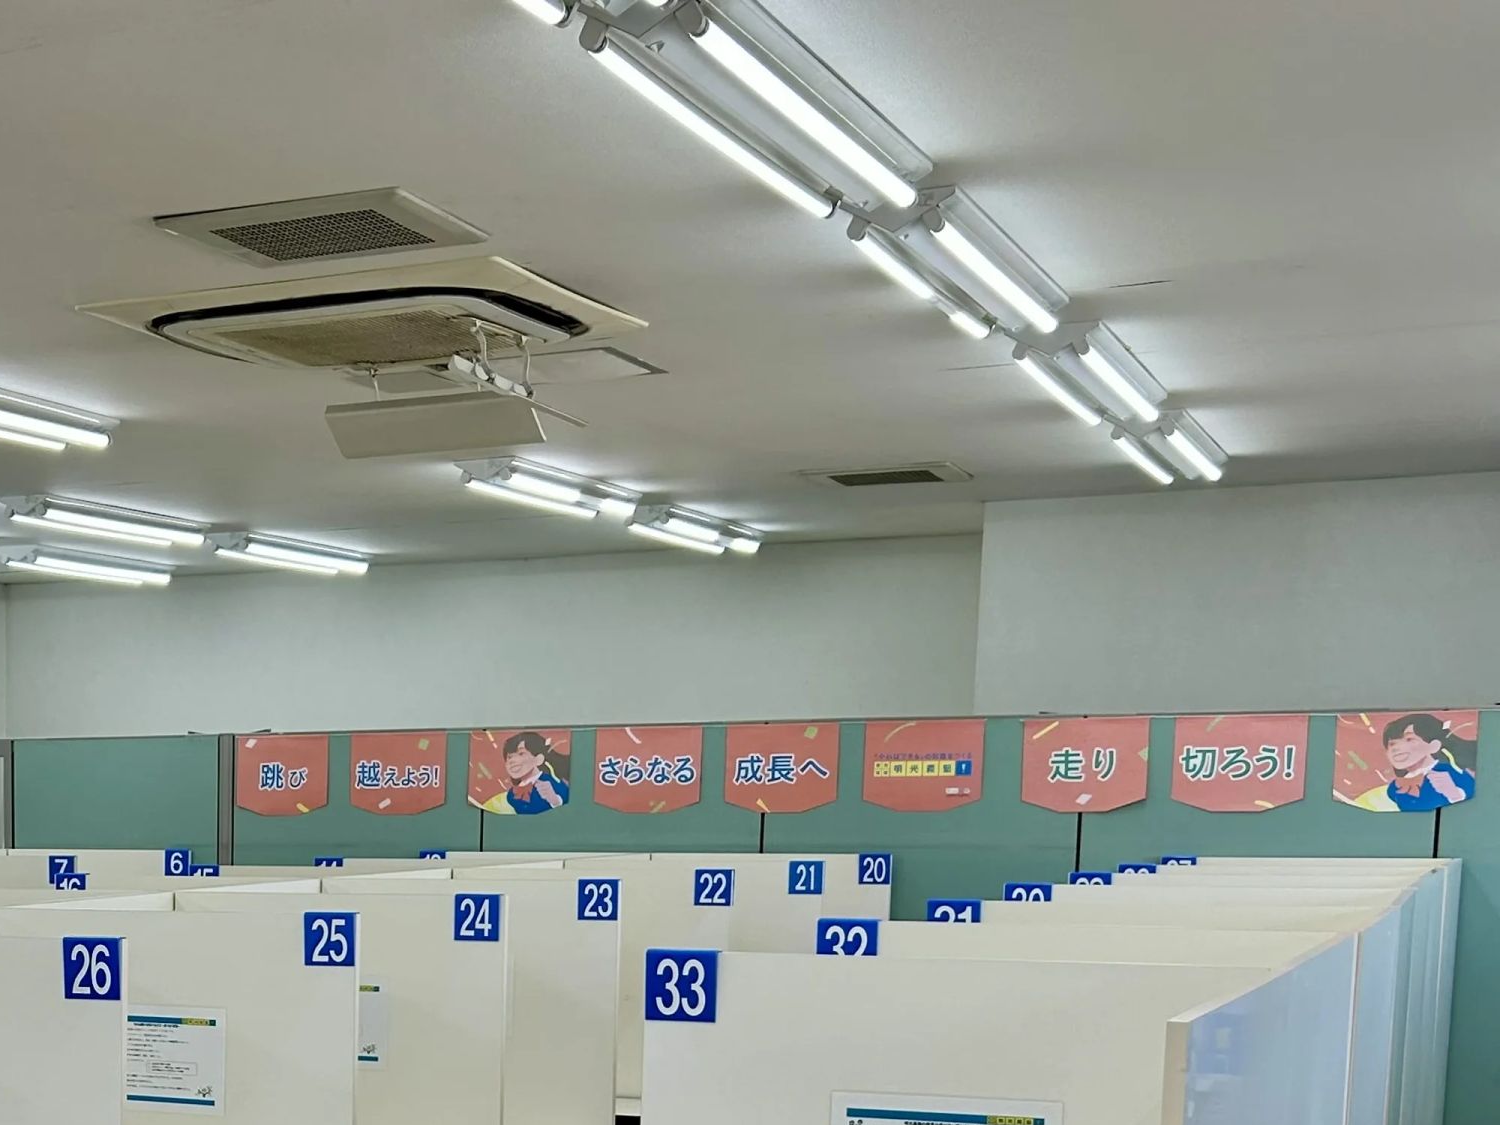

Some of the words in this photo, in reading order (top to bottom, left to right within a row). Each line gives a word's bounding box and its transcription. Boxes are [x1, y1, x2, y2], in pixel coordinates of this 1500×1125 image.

[260, 763, 307, 788] 跳び
[356, 762, 440, 787] 越えよう!
[601, 757, 696, 783] さらなる
[735, 755, 829, 783] 成長へ
[1051, 749, 1115, 780] 走り
[1182, 747, 1294, 779] 切ろう!
[170, 852, 183, 874] 6
[795, 864, 815, 890] 21
[863, 858, 886, 882] 20
[584, 884, 613, 917] 23
[700, 873, 726, 904] 22
[459, 899, 491, 936] 24
[312, 919, 348, 962] 25
[71, 944, 111, 995] 26
[656, 959, 705, 1016] 33
